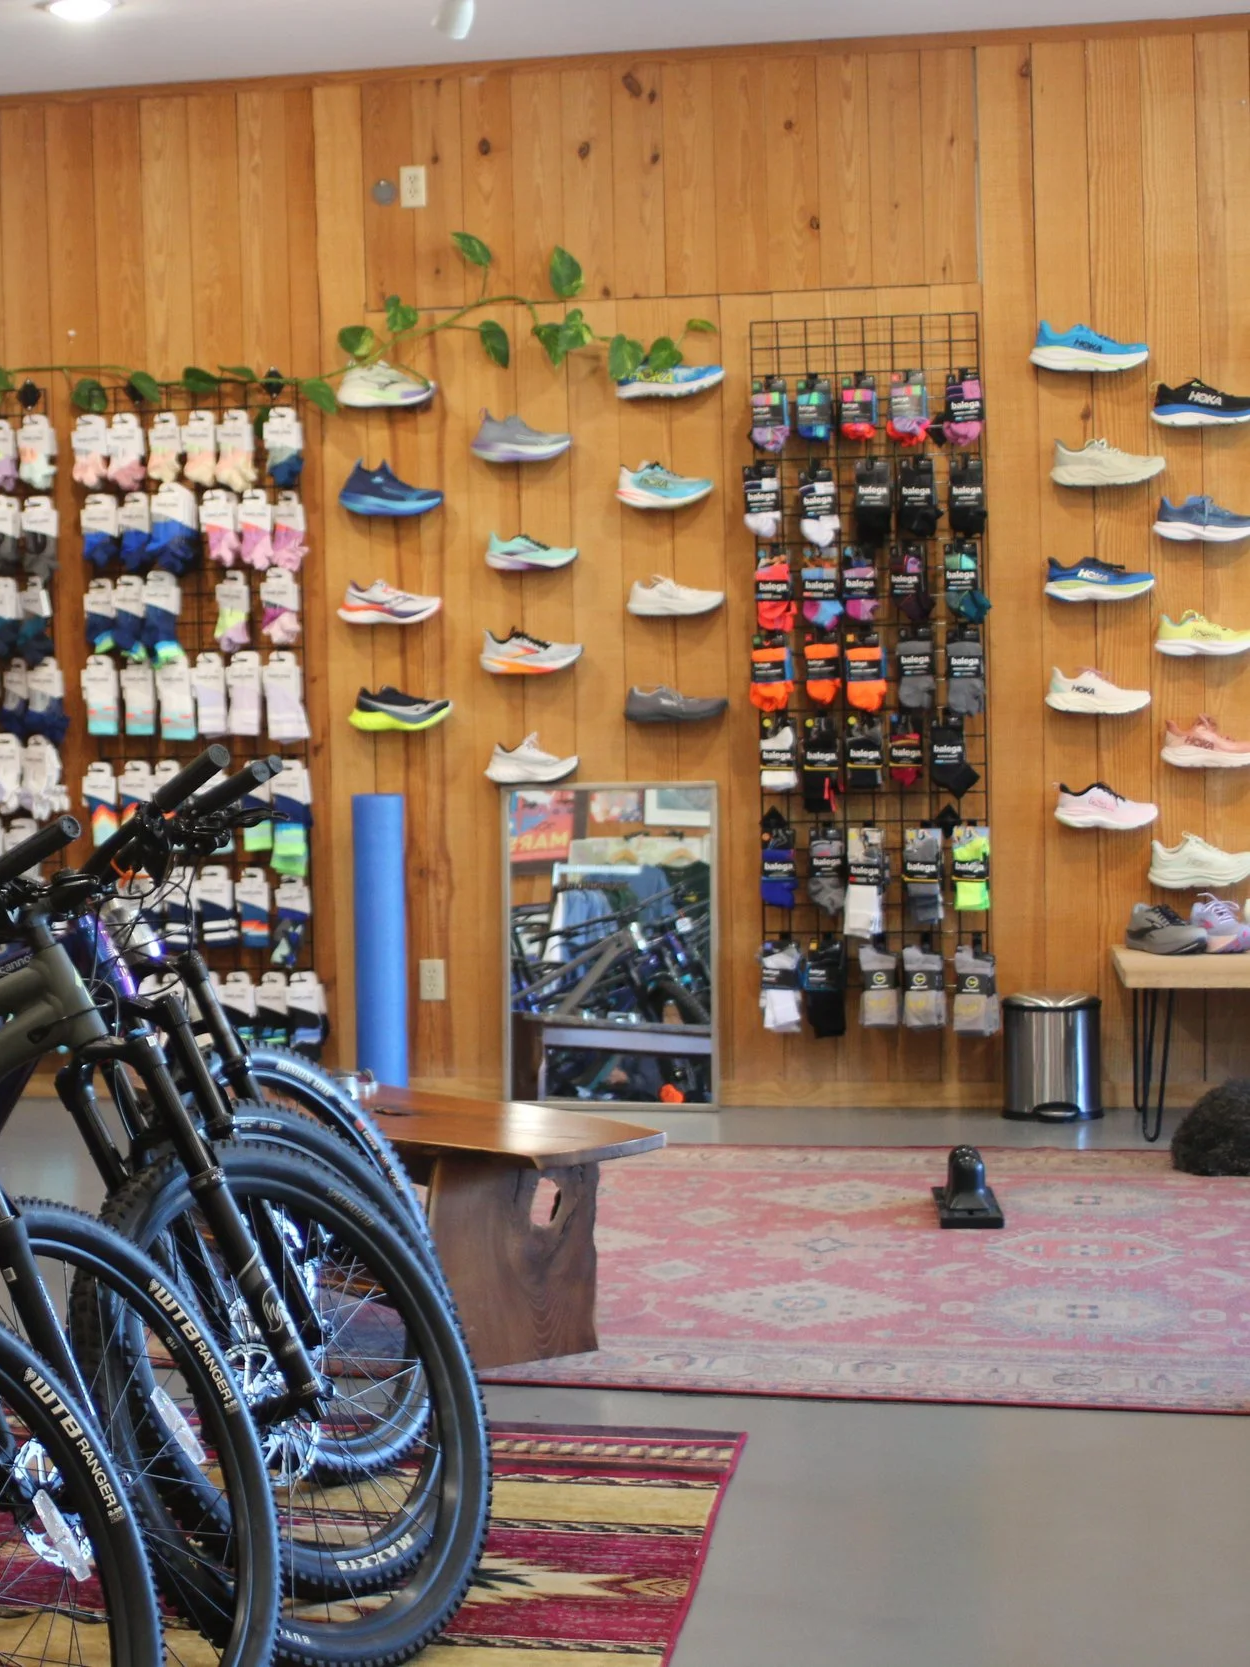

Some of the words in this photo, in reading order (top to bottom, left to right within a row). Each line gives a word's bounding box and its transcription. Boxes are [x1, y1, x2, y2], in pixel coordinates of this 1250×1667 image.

[1188, 390, 1223, 406] HOKA
[951, 400, 980, 411] balega
[859, 485, 887, 496] balega
[902, 486, 931, 497] balega
[952, 485, 981, 496] balega
[747, 492, 776, 502] balega
[803, 496, 832, 506] balega
[891, 575, 918, 585] balega
[946, 570, 975, 580] balega
[1077, 569, 1108, 583] HOKA
[759, 582, 788, 592] balega
[805, 581, 835, 591] balega
[846, 579, 875, 589] balega
[901, 655, 930, 665] balega
[951, 657, 980, 667] balega
[1071, 684, 1095, 695] HOKA
[1185, 736, 1215, 750] HOKA
[892, 748, 921, 759] balega
[933, 744, 963, 754] balega
[762, 751, 792, 761] balega
[807, 751, 837, 761] balega
[850, 749, 880, 760] balega
[764, 862, 793, 872] balega
[813, 857, 841, 868] balega
[907, 862, 936, 872] balega
[850, 866, 879, 876] balega
[154, 1287, 200, 1342] WTB
[194, 1340, 232, 1399] RANGER
[30, 1376, 83, 1438] WTB
[76, 1437, 118, 1508] RANGER
[336, 1533, 413, 1571] MAXXIS
